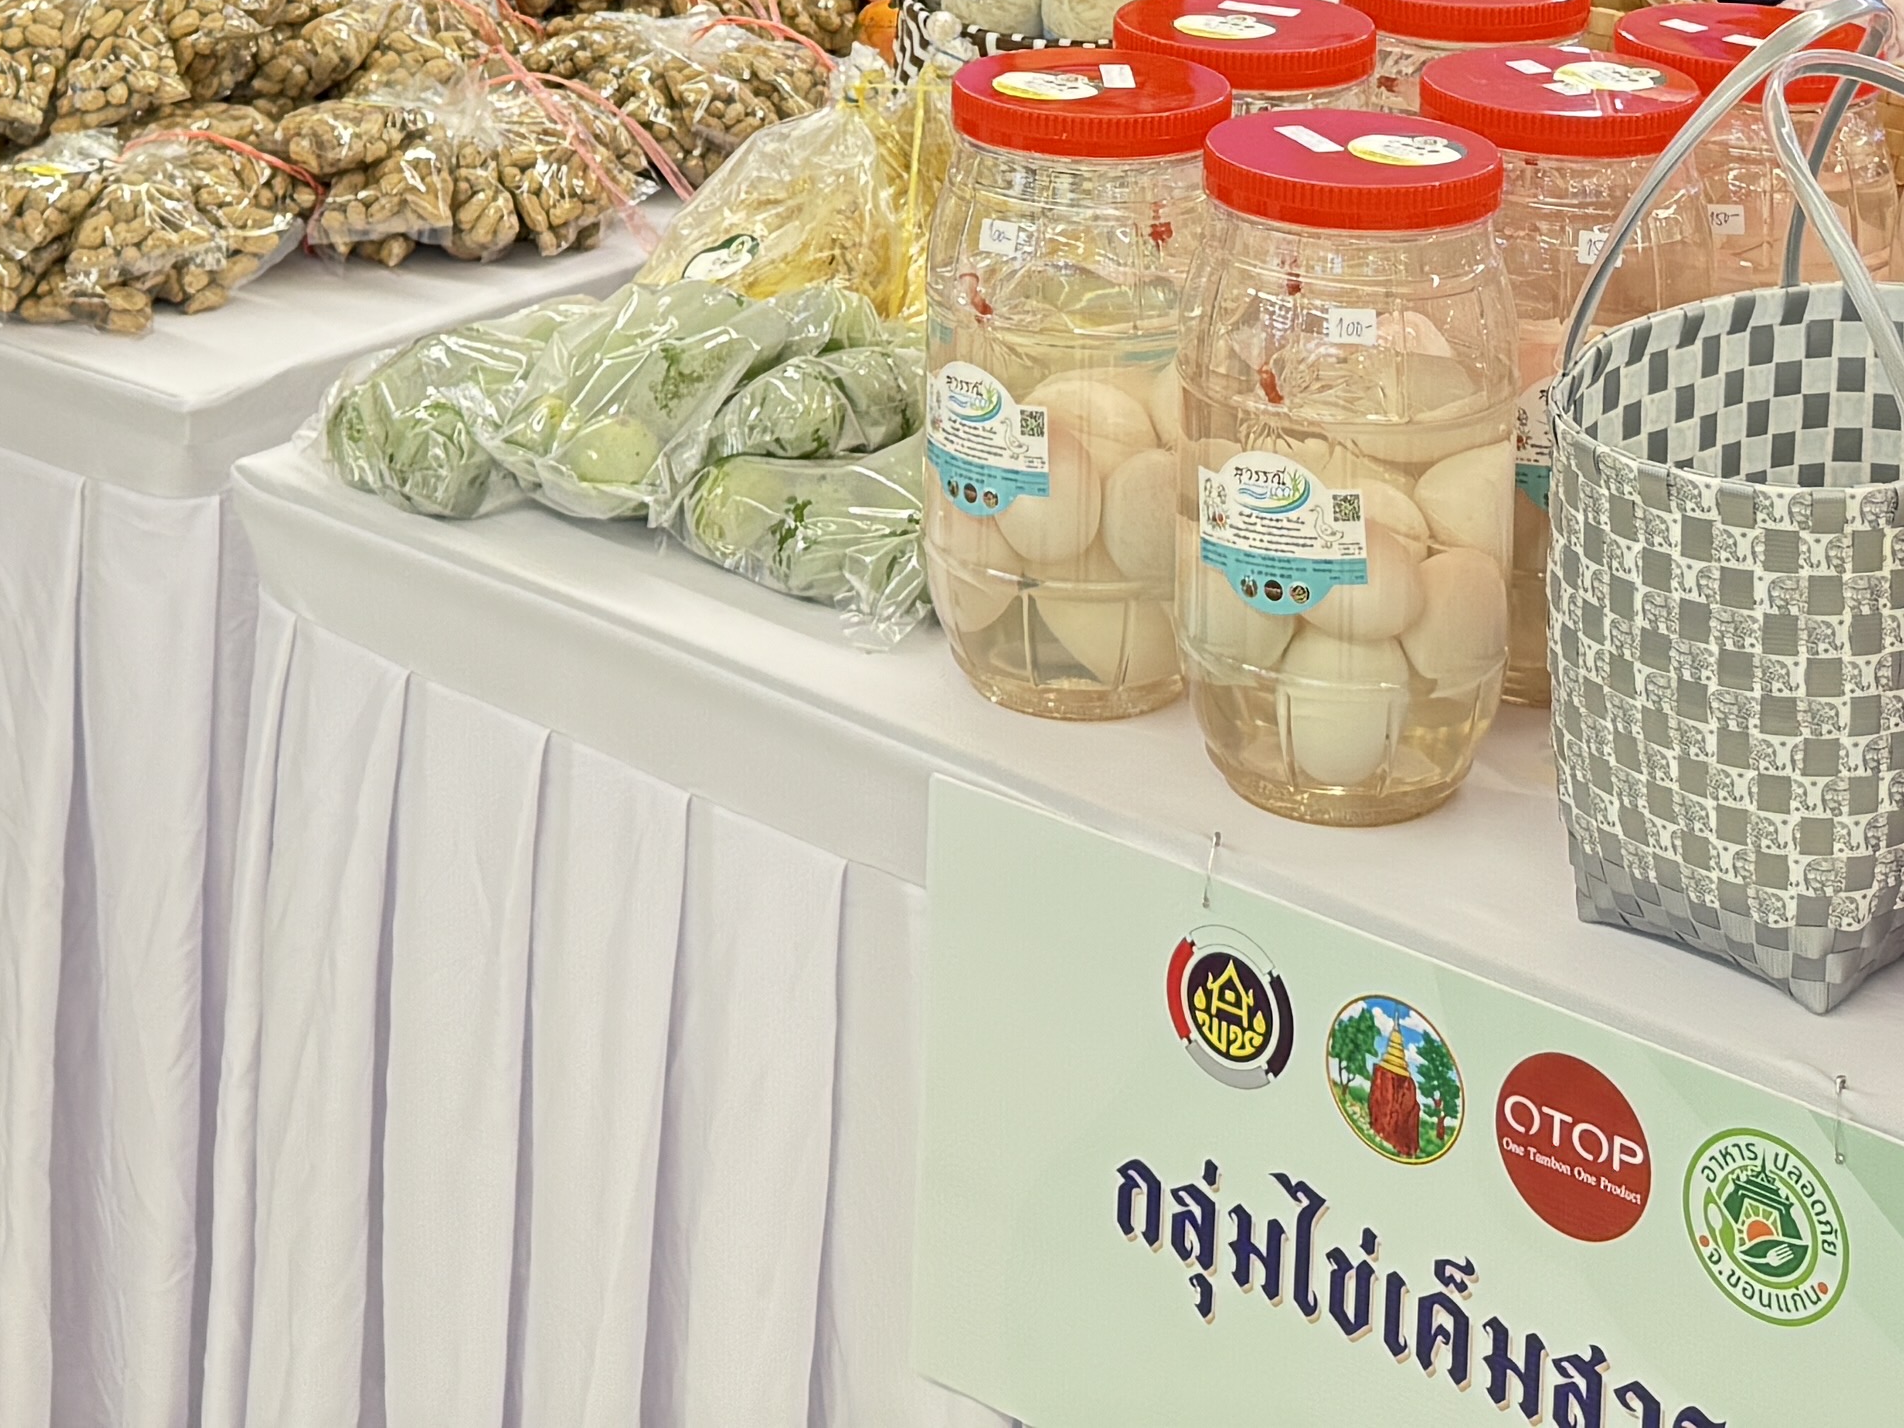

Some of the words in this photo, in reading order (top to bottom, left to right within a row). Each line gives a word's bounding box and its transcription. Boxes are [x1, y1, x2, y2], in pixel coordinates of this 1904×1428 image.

[1502, 1136, 1526, 1158] One
[1573, 1163, 1598, 1188] One
[1599, 1176, 1643, 1206] Product
[1503, 1094, 1645, 1173] OTOP
[1700, 1142, 1760, 1184] อาหาร
[1773, 1150, 1840, 1257] ปลอดภัย
